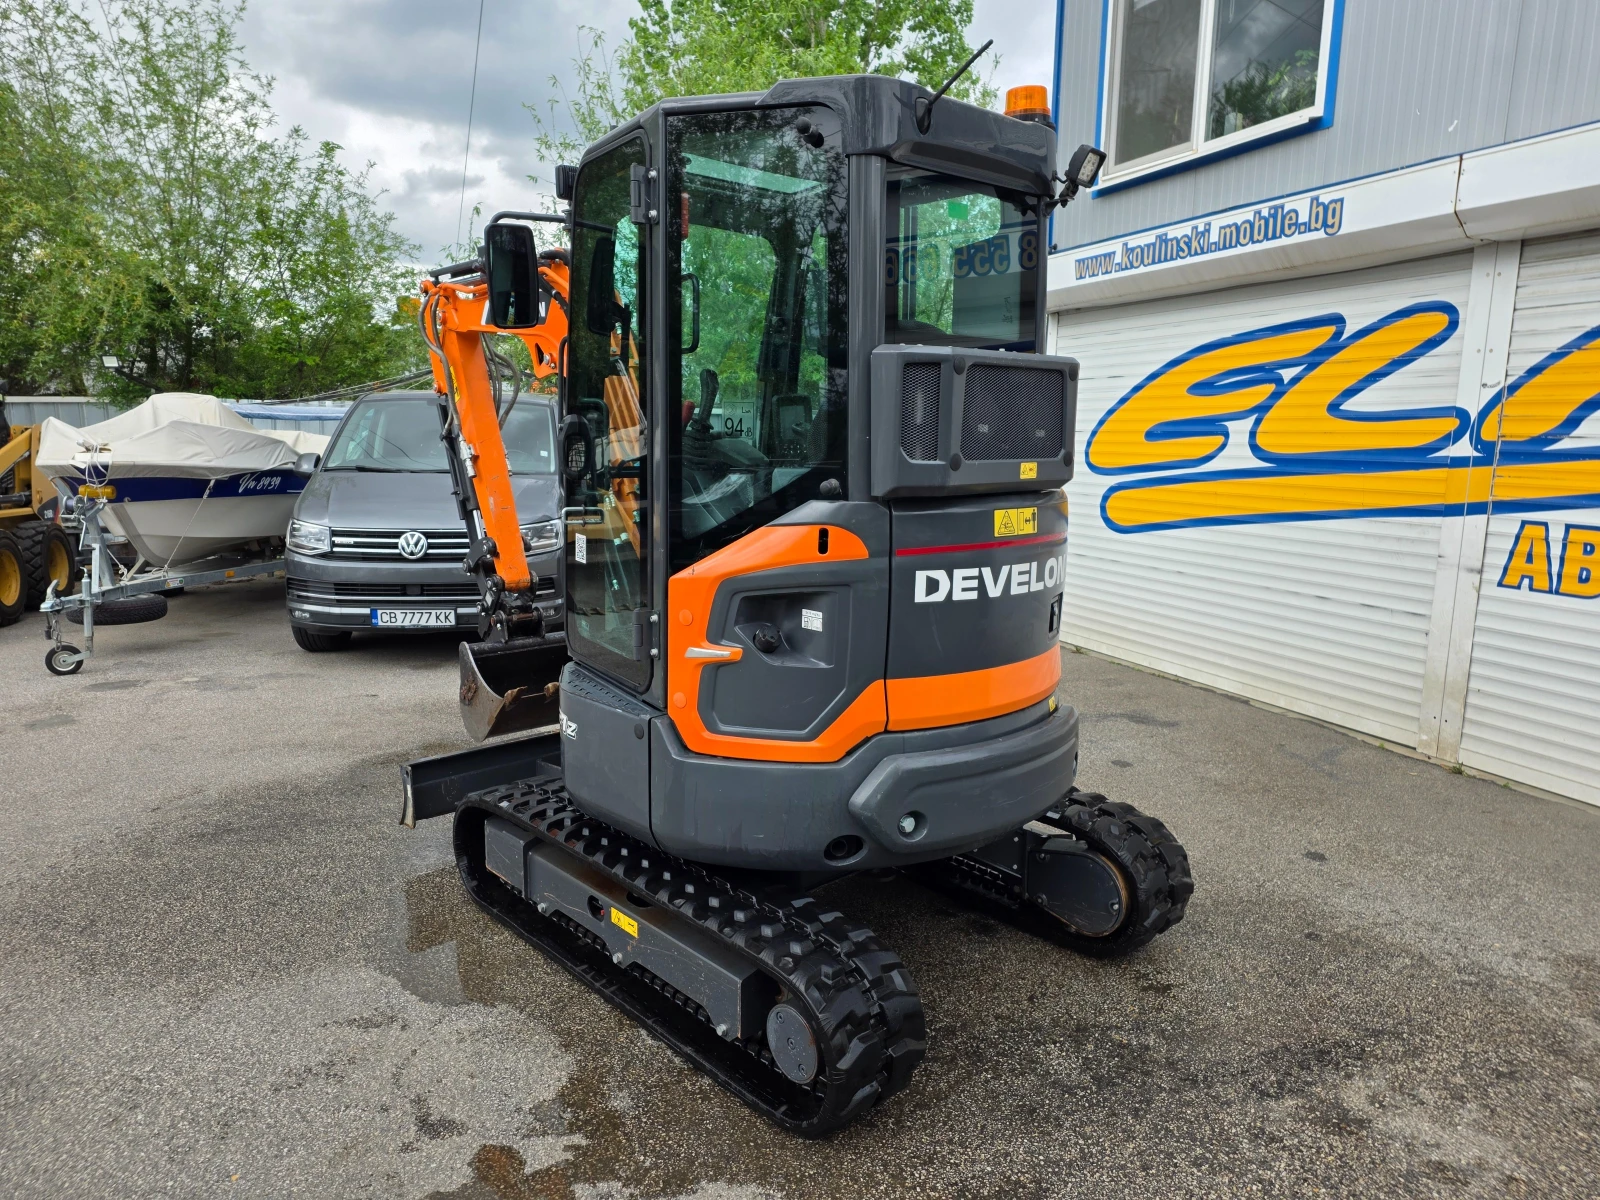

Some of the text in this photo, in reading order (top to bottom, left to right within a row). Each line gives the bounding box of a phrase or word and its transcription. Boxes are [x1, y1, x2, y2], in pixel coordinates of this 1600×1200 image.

[1075, 195, 1344, 280] www.koulinski.mobile.bg
[725, 417, 744, 437] 94
[380, 611, 398, 624] CB
[400, 611, 432, 624] 7777
[435, 611, 453, 624] KK
